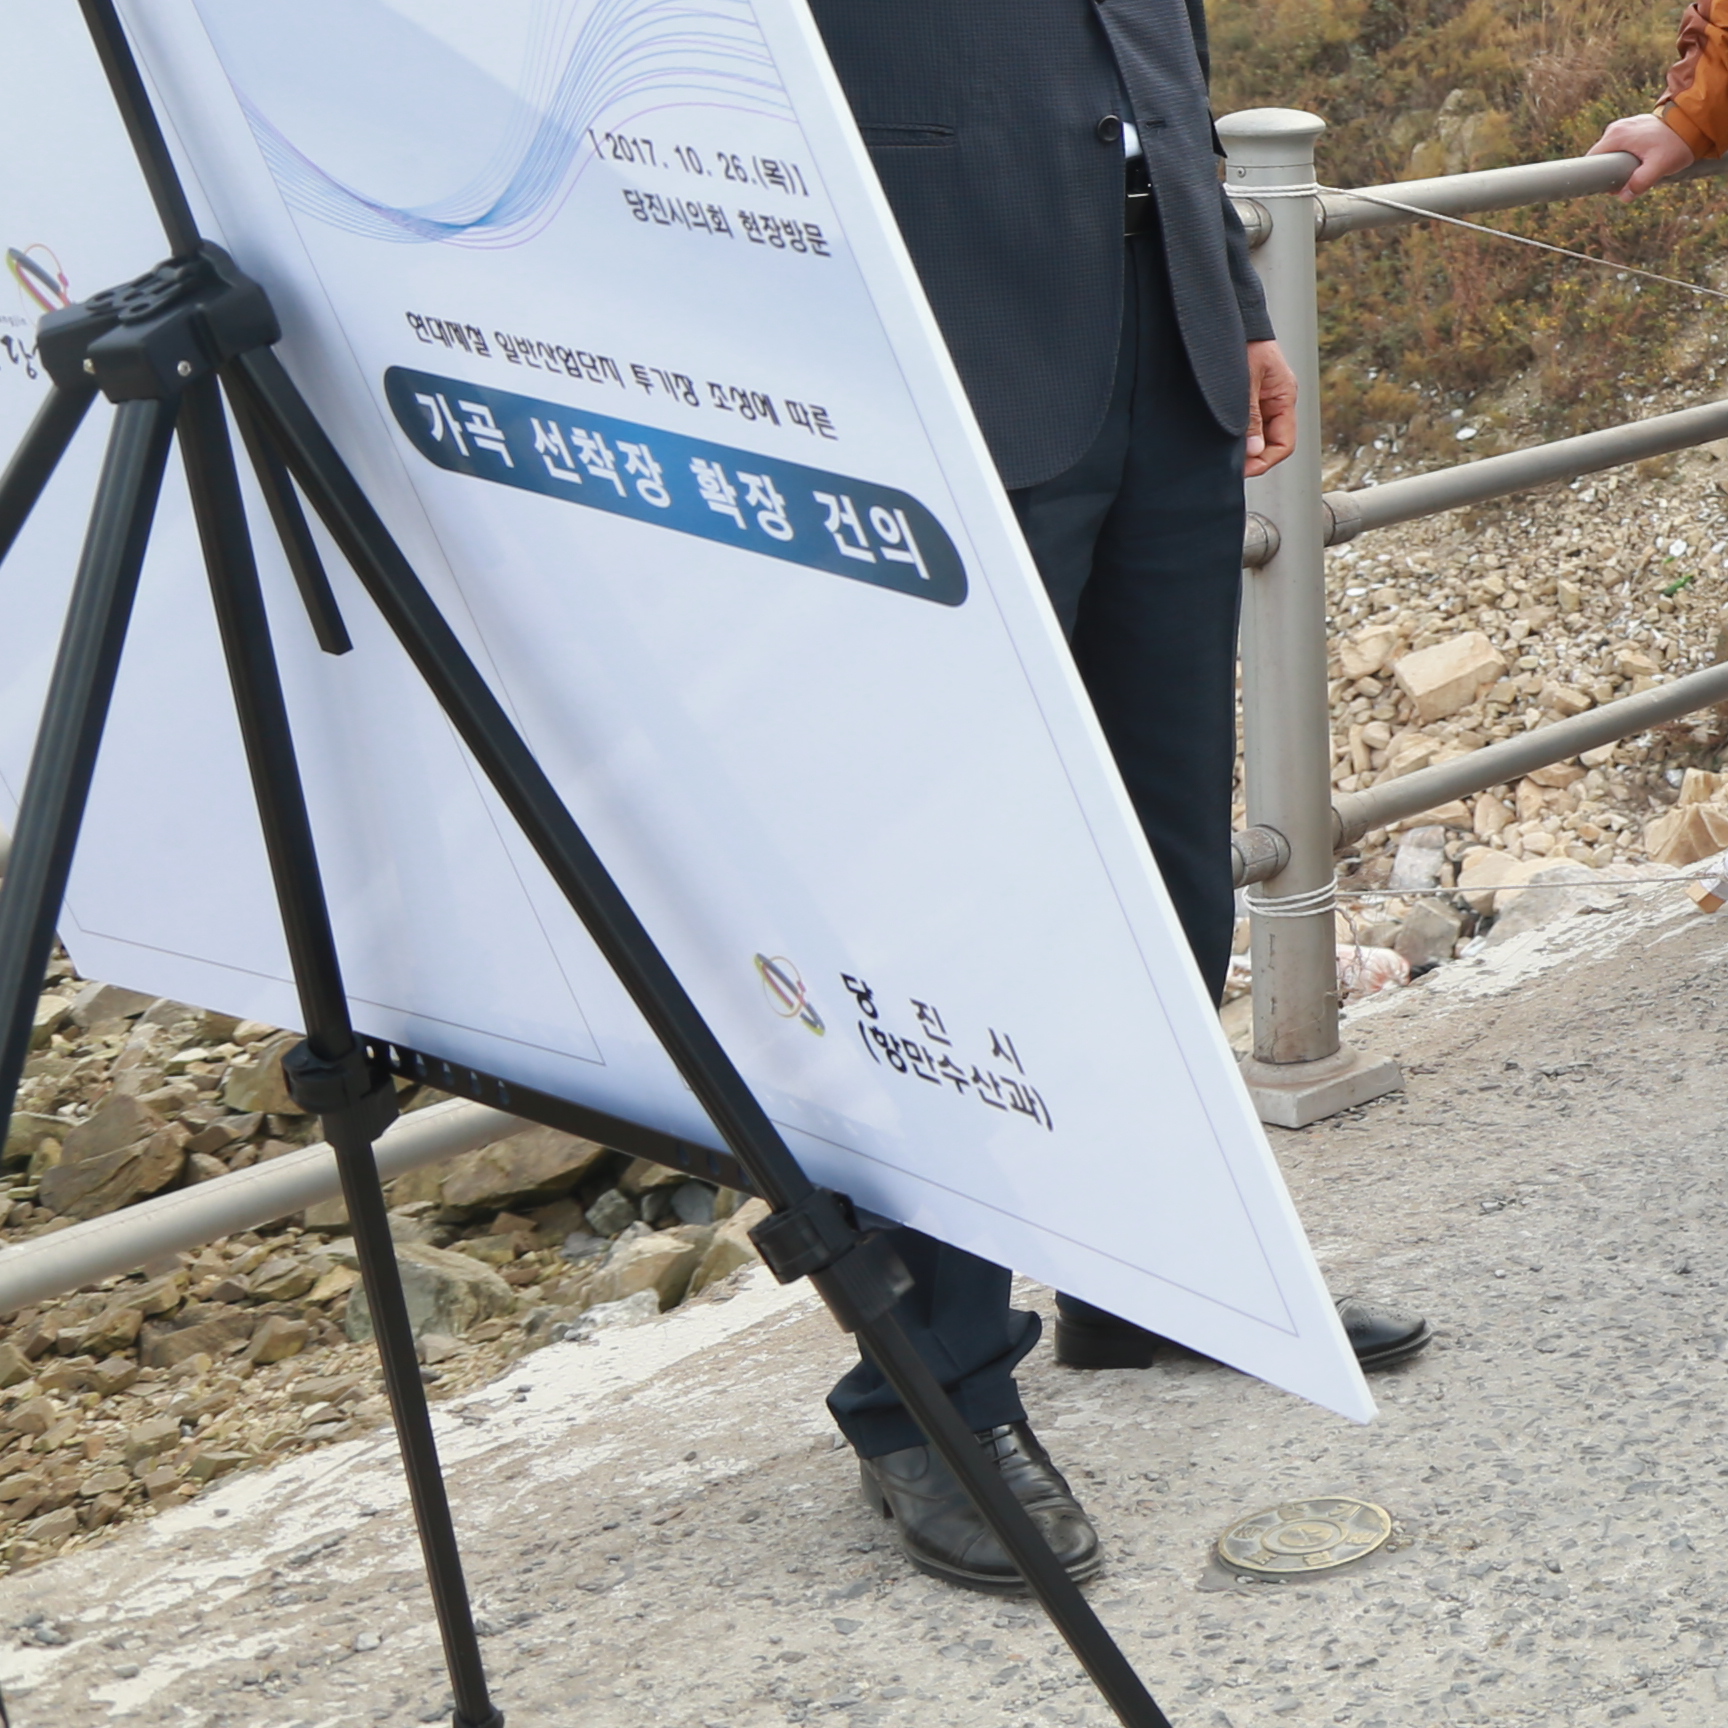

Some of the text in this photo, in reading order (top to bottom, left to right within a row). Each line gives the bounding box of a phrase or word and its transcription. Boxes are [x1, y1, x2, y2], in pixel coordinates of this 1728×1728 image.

[621, 188, 833, 258] 당진시의회 현장방문
[493, 330, 626, 390] 일반산업단지
[629, 362, 701, 408] 투기장
[706, 381, 782, 427] 조성에
[783, 398, 839, 441] 따른
[414, 391, 931, 581] 가곡 선착장 확장 건의
[858, 1019, 1054, 1132] (항만수산과)
